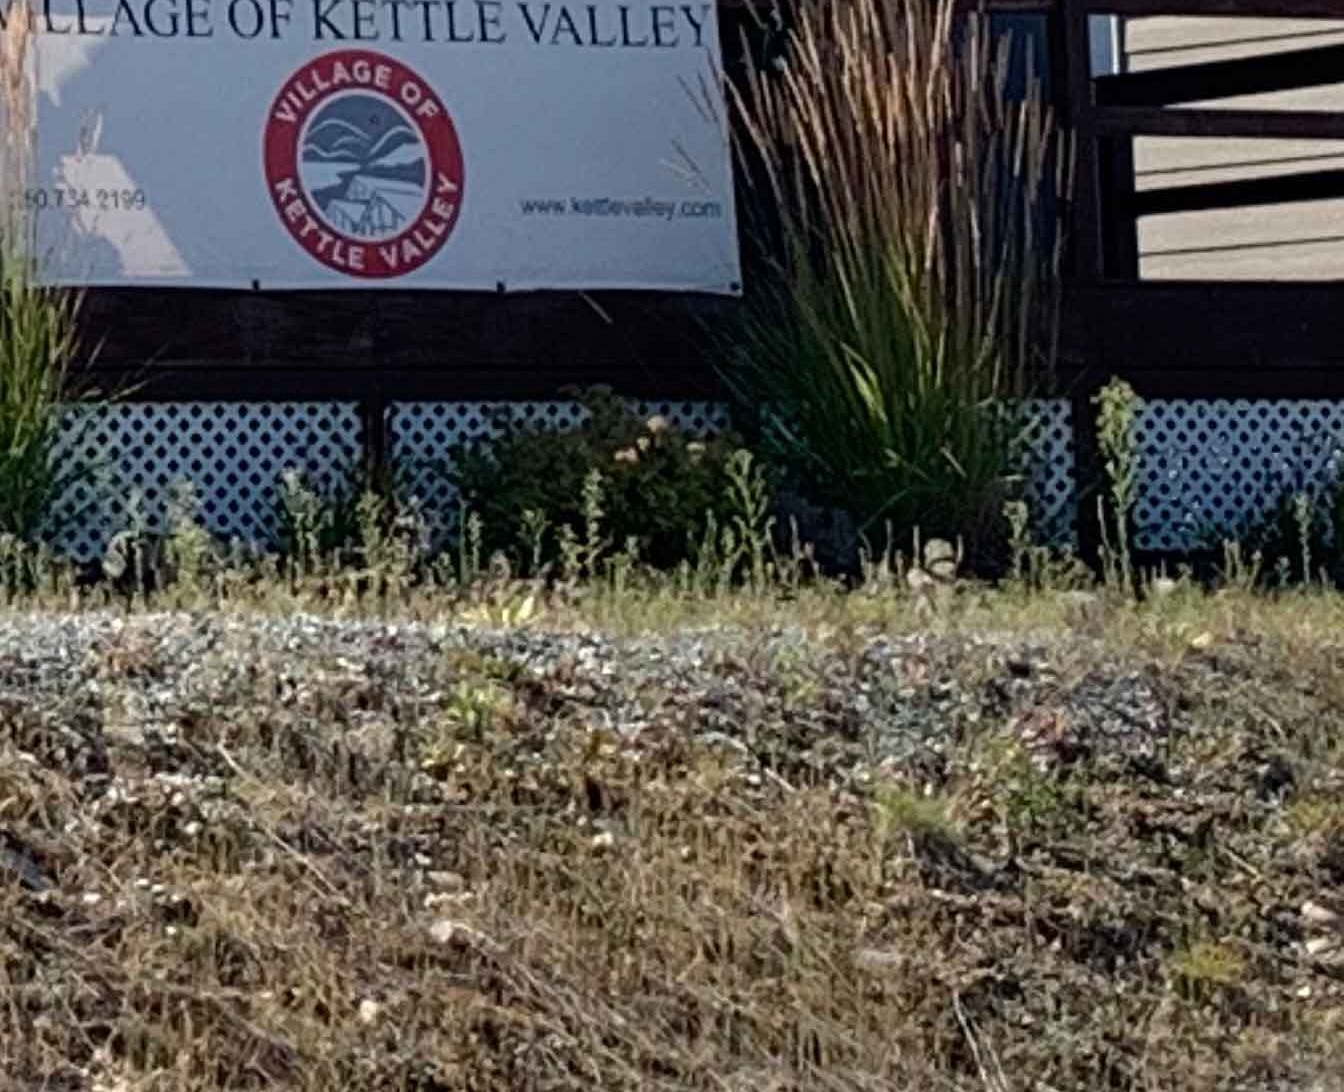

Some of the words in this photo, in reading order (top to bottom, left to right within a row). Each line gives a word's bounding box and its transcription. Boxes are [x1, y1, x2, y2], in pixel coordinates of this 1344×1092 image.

[516, 2, 712, 49] VALLEY
[274, 59, 393, 125] VILLAGE
[400, 81, 440, 119] OF
[274, 177, 366, 271] KETTLE
[378, 172, 459, 268] VALLEY
[520, 195, 721, 221] www.kettlevalley.com
